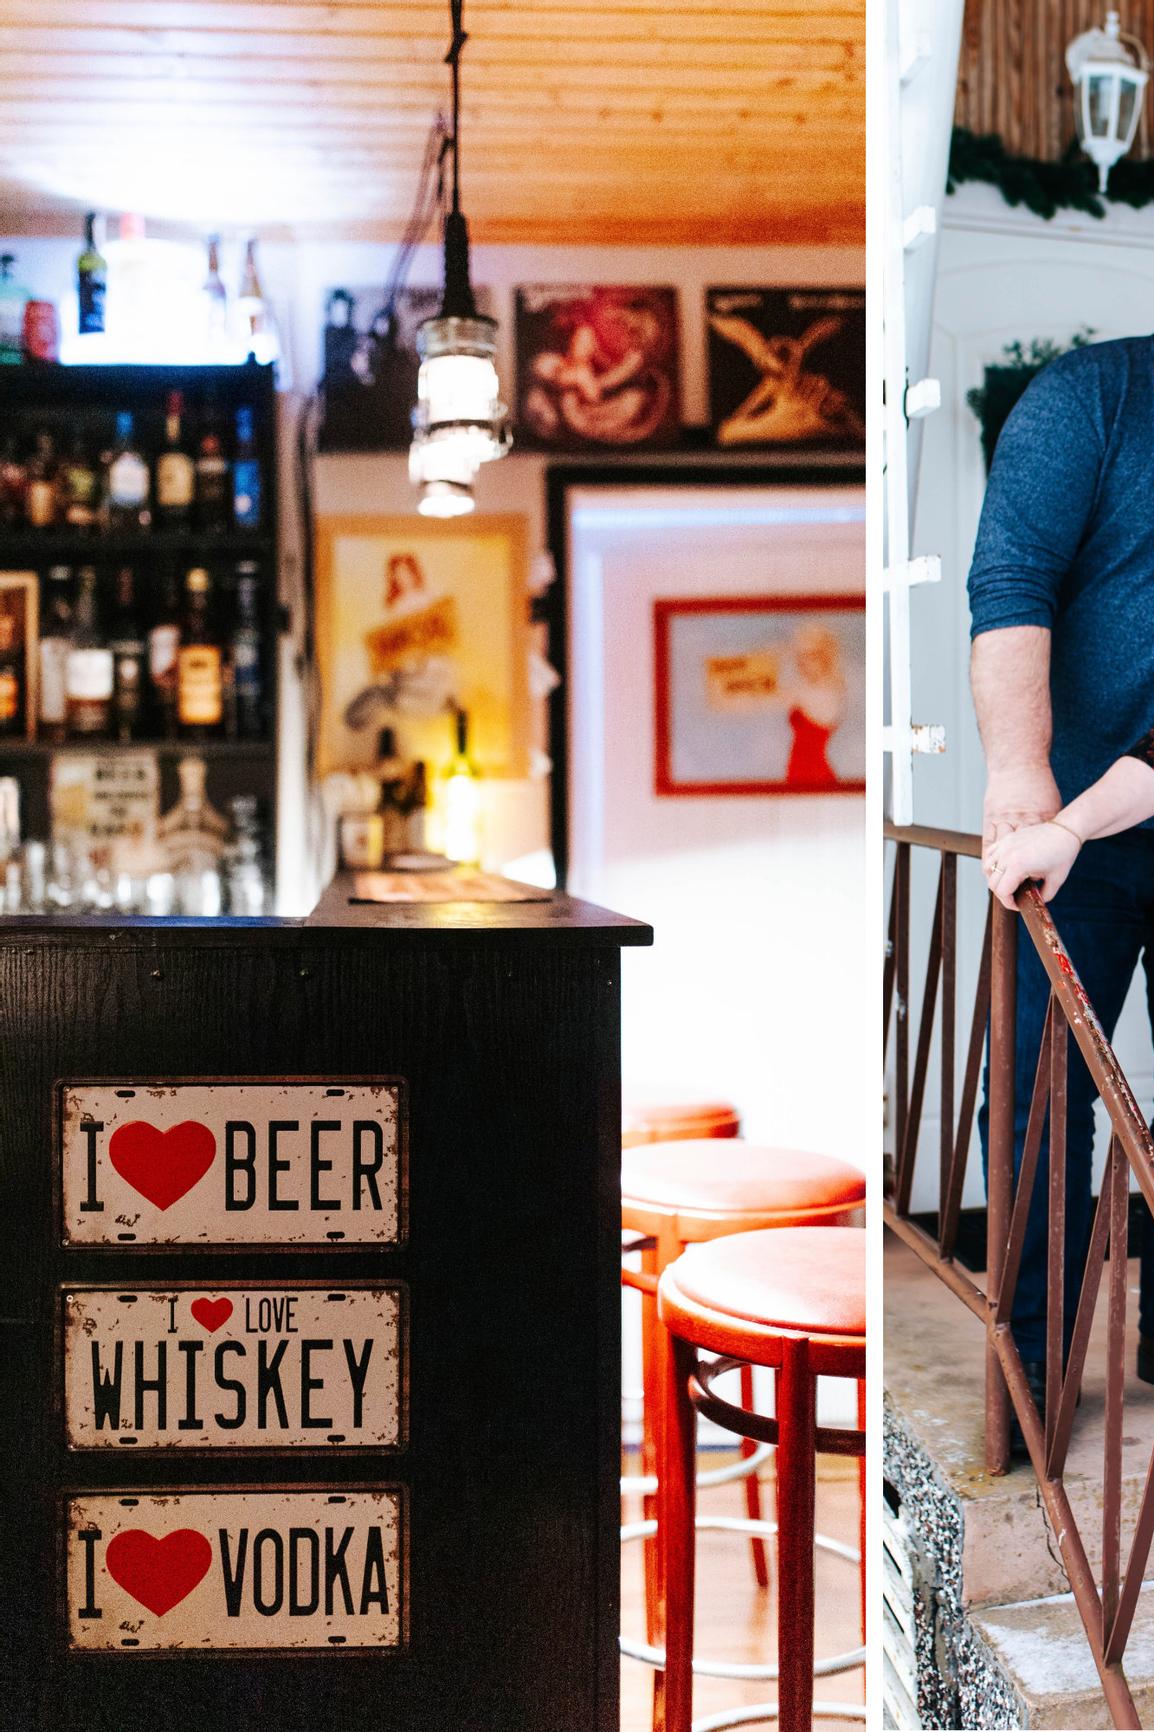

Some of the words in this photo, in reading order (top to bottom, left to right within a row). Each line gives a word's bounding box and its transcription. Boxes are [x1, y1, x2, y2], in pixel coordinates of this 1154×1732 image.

[80, 1121, 104, 1212] I
[224, 1120, 384, 1211] BEER
[167, 1298, 178, 1333] I
[245, 1297, 299, 1333] LOVE
[91, 1338, 374, 1430] WHISKEY
[78, 1530, 102, 1619] I
[219, 1527, 389, 1617] VODKA
